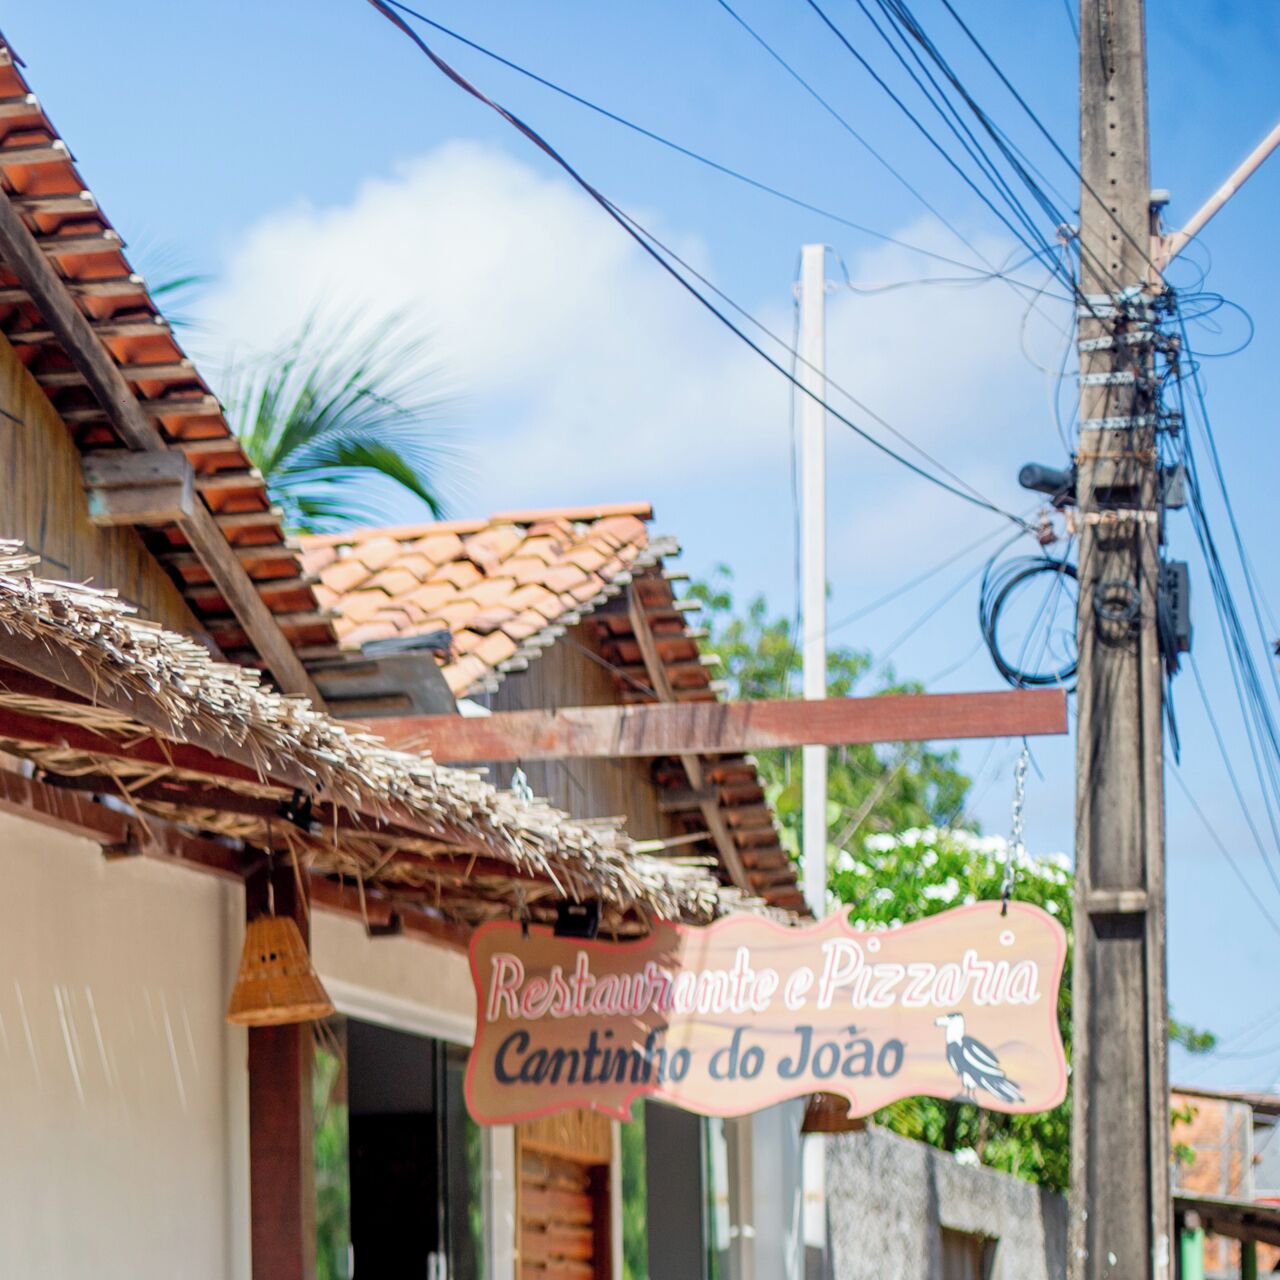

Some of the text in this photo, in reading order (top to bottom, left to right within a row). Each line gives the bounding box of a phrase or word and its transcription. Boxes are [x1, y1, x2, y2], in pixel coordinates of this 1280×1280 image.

[487, 931, 1041, 1021] Restaurante e Pizzaria
[493, 1025, 904, 1085] Cantinho do João
